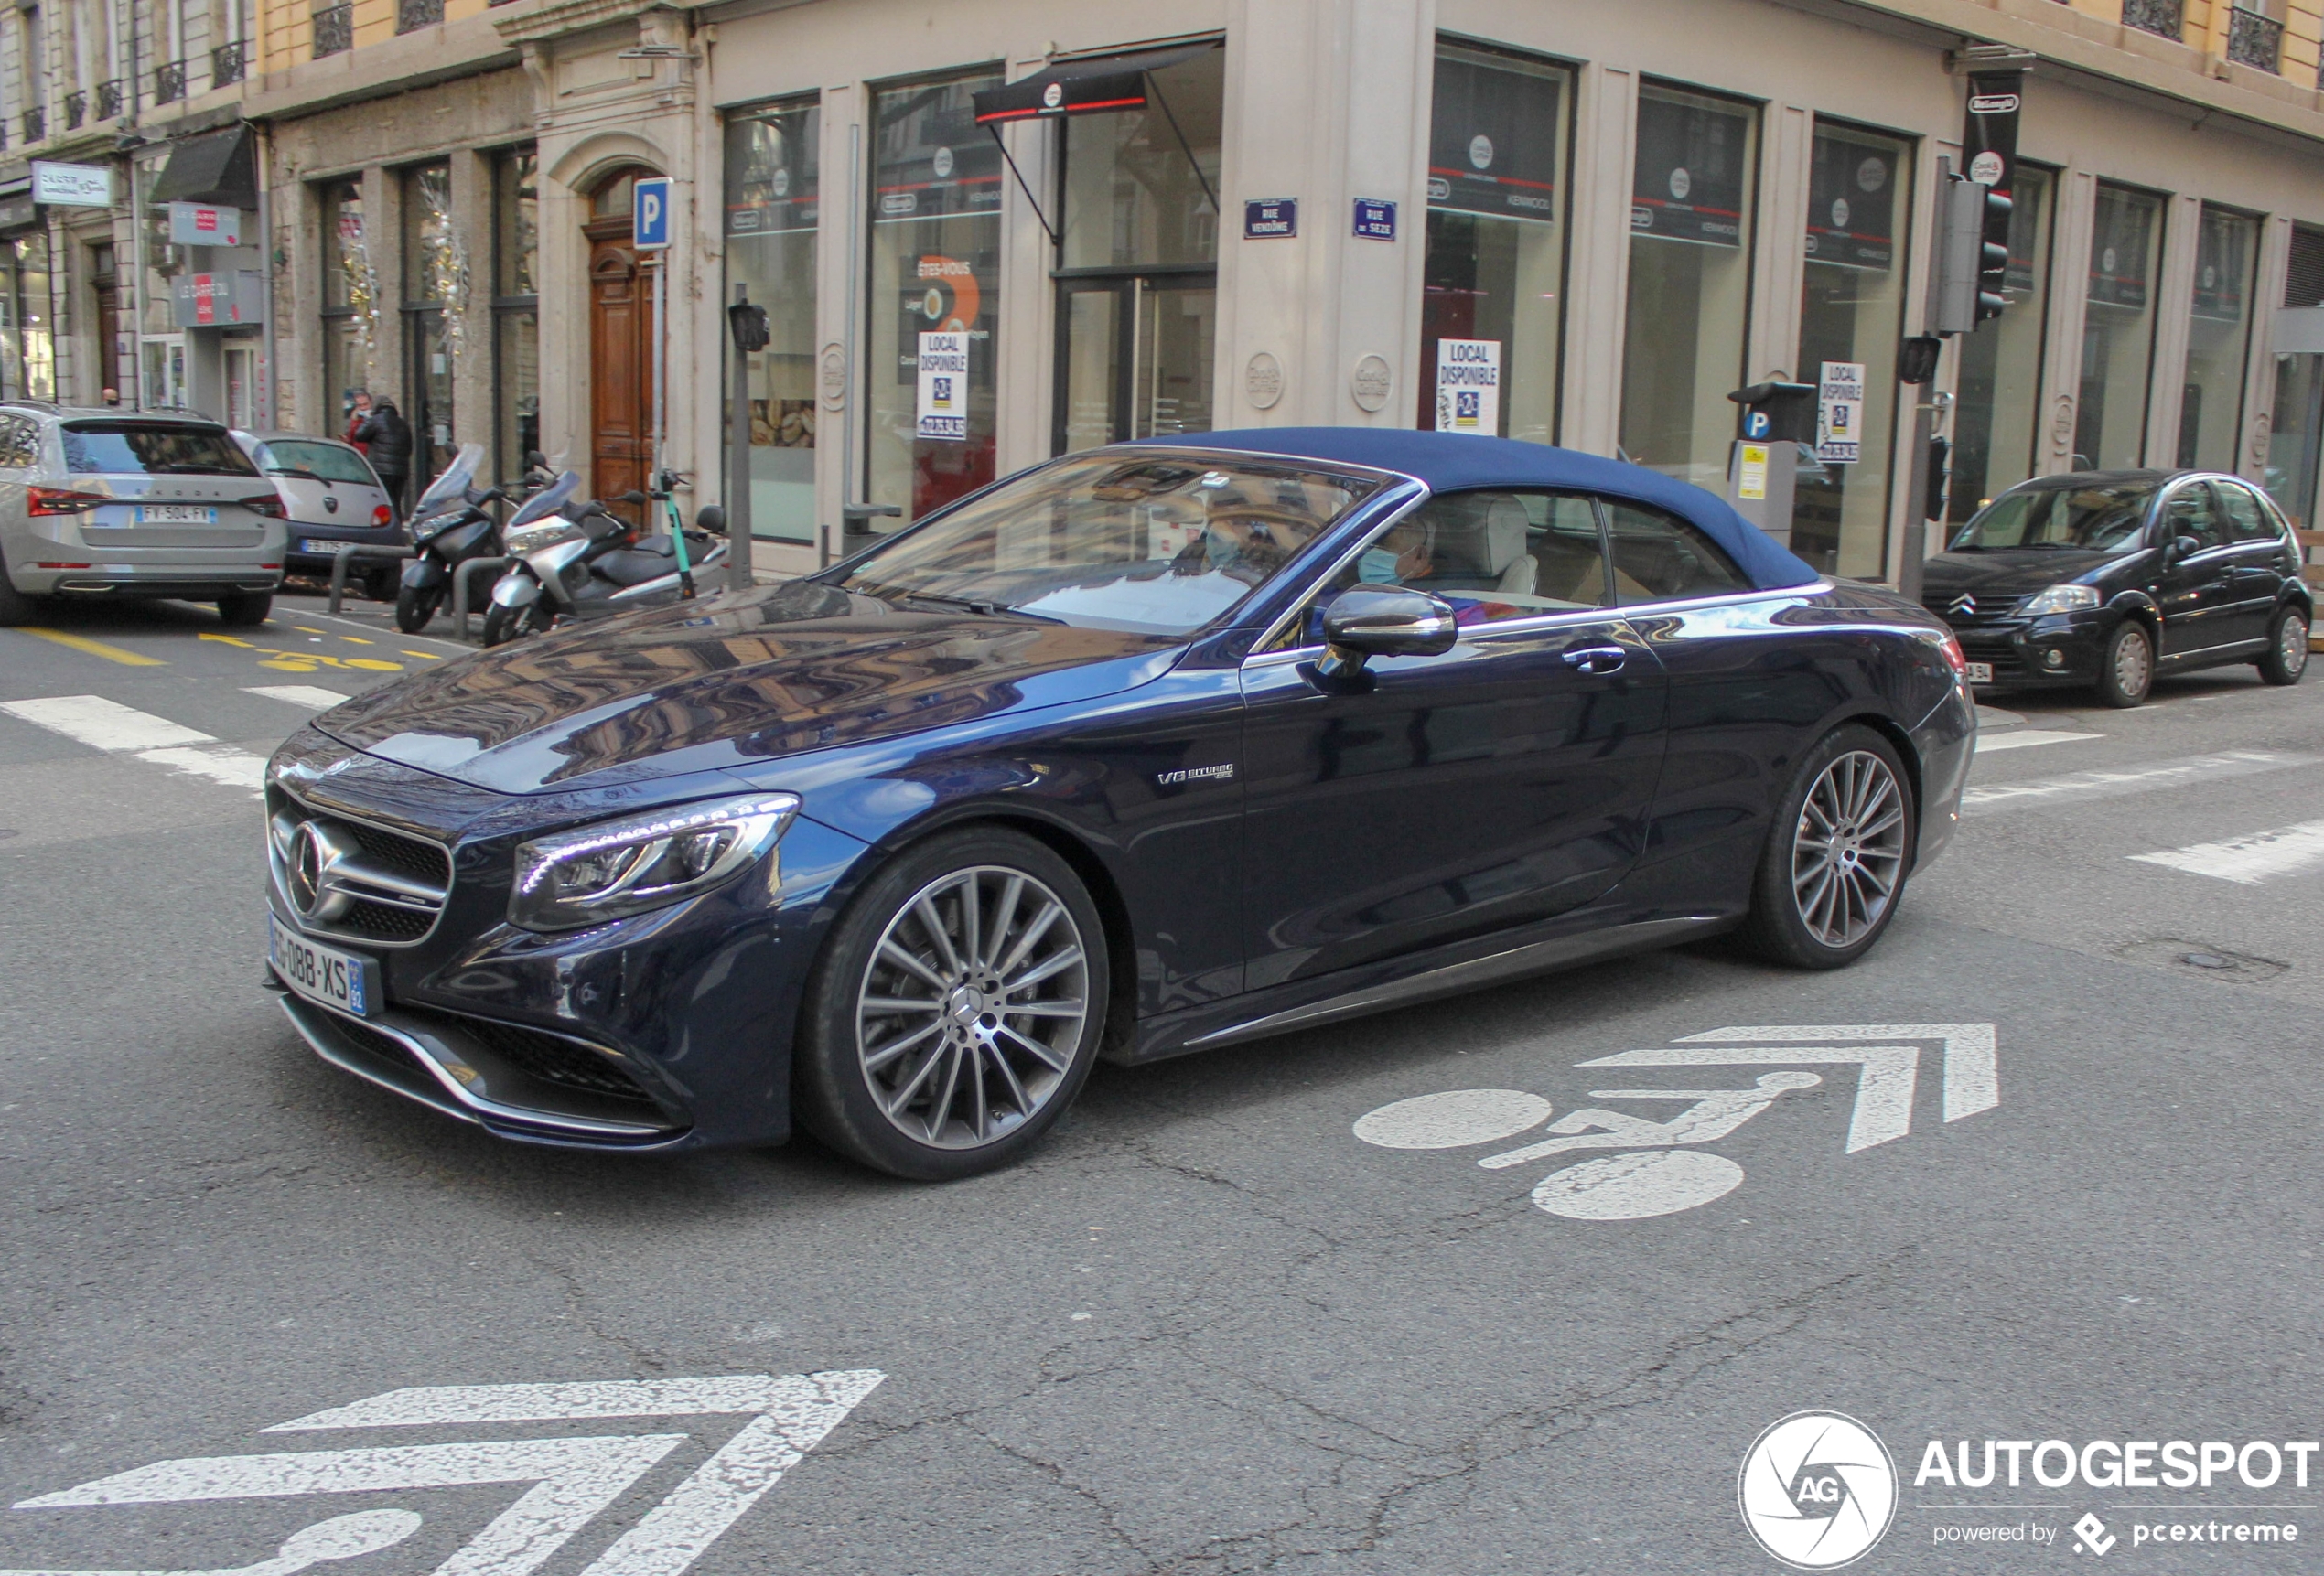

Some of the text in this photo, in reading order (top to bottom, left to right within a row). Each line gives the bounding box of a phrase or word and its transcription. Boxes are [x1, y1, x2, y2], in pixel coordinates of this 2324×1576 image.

[643, 194, 661, 234] P
[1262, 209, 1279, 219] RUE
[1366, 209, 1384, 220] RUE
[928, 336, 959, 351] LOCAL
[1451, 344, 1489, 362] LOCAL
[921, 355, 965, 372] DISPONIBLE
[1441, 366, 1496, 386] DISPONIBLE
[1830, 367, 1856, 381] LOCAL
[1823, 383, 1861, 401] DISPONIBLE
[1750, 412, 1770, 436] P
[1157, 770, 1186, 784] V8
[1188, 763, 1233, 777] BITURBO
